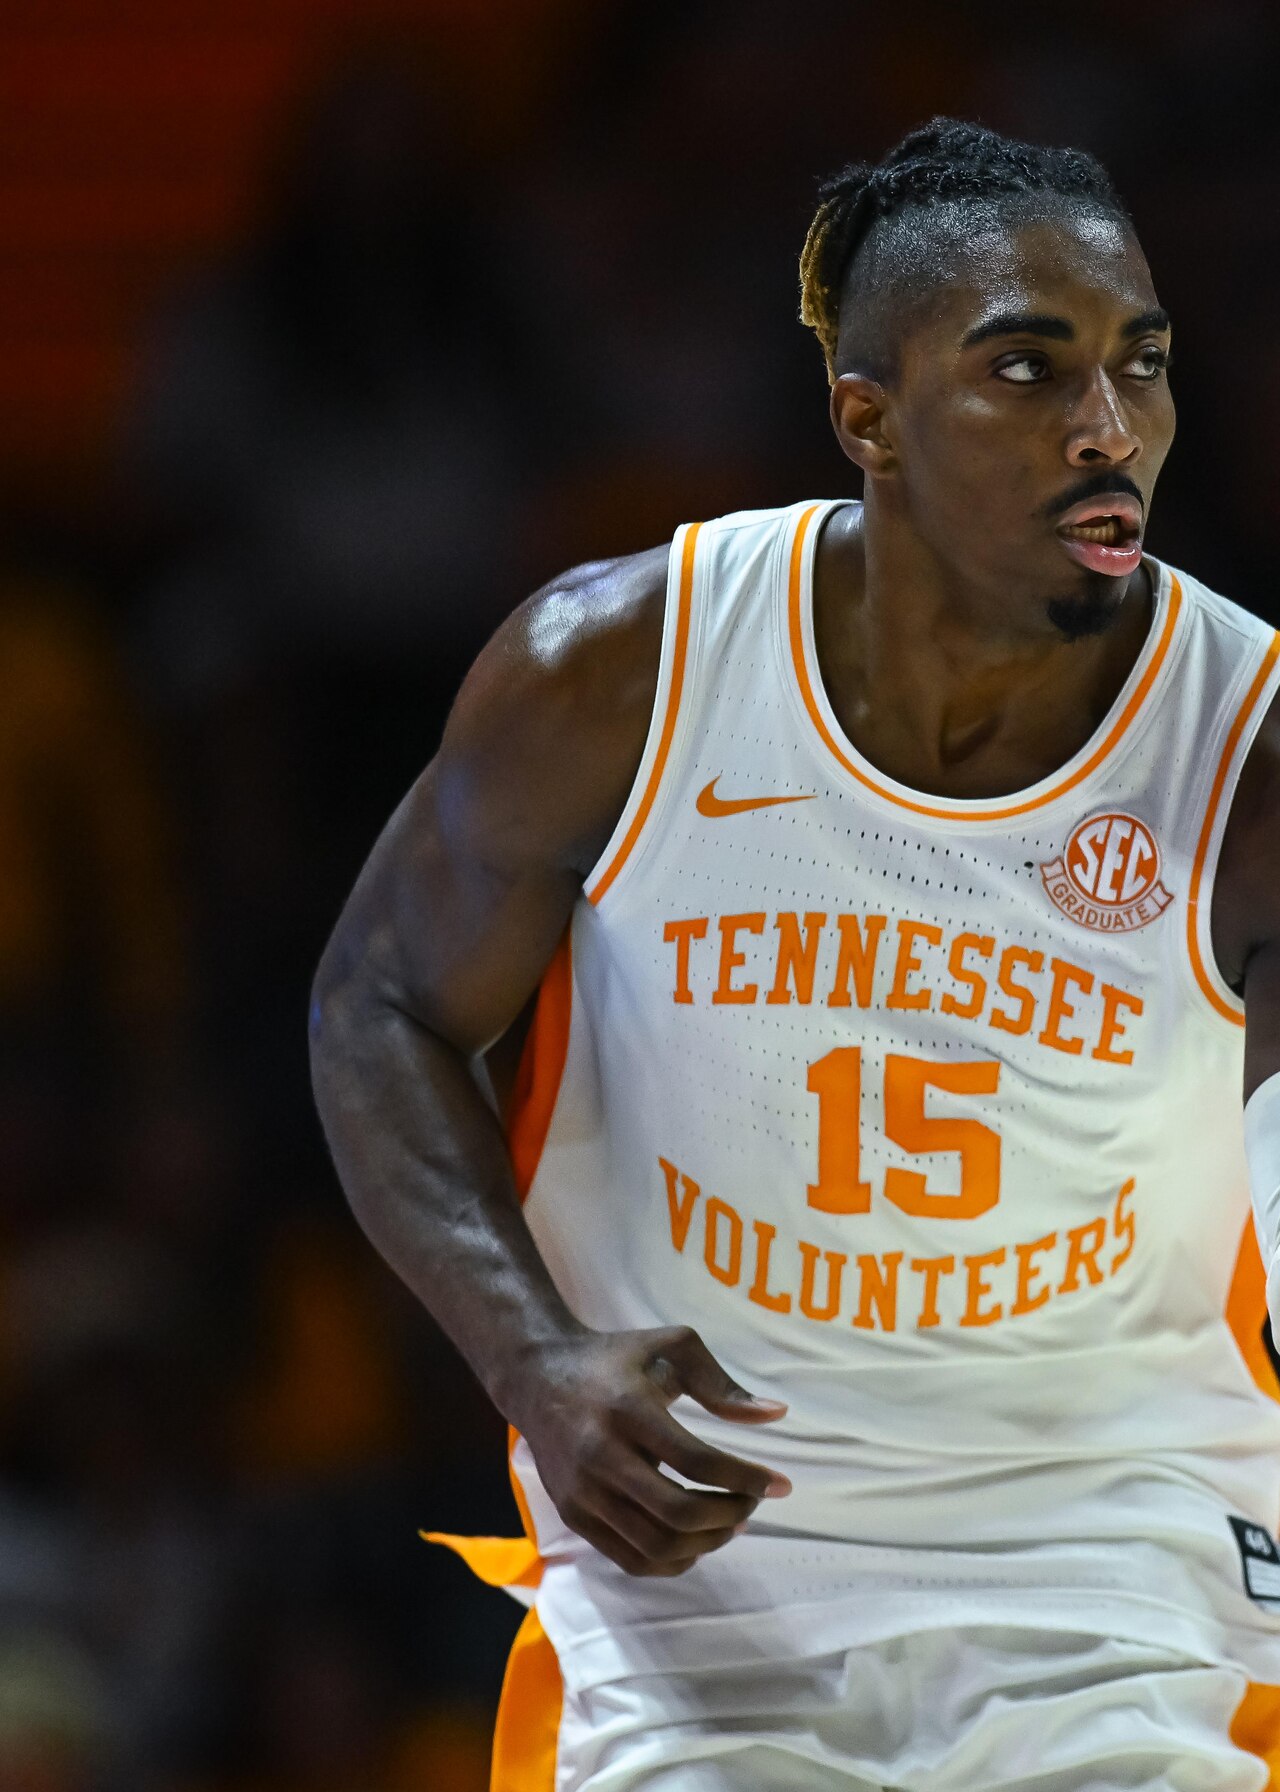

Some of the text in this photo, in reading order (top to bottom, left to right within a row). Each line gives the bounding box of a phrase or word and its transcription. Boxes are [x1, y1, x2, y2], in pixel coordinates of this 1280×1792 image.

[1052, 883, 1150, 929] GRADUATE
[1073, 818, 1152, 902] SEC
[663, 912, 1144, 1066] TENNESSEE
[806, 1046, 1001, 1220] 15
[659, 1156, 1136, 1333] VOLUNTEERS
